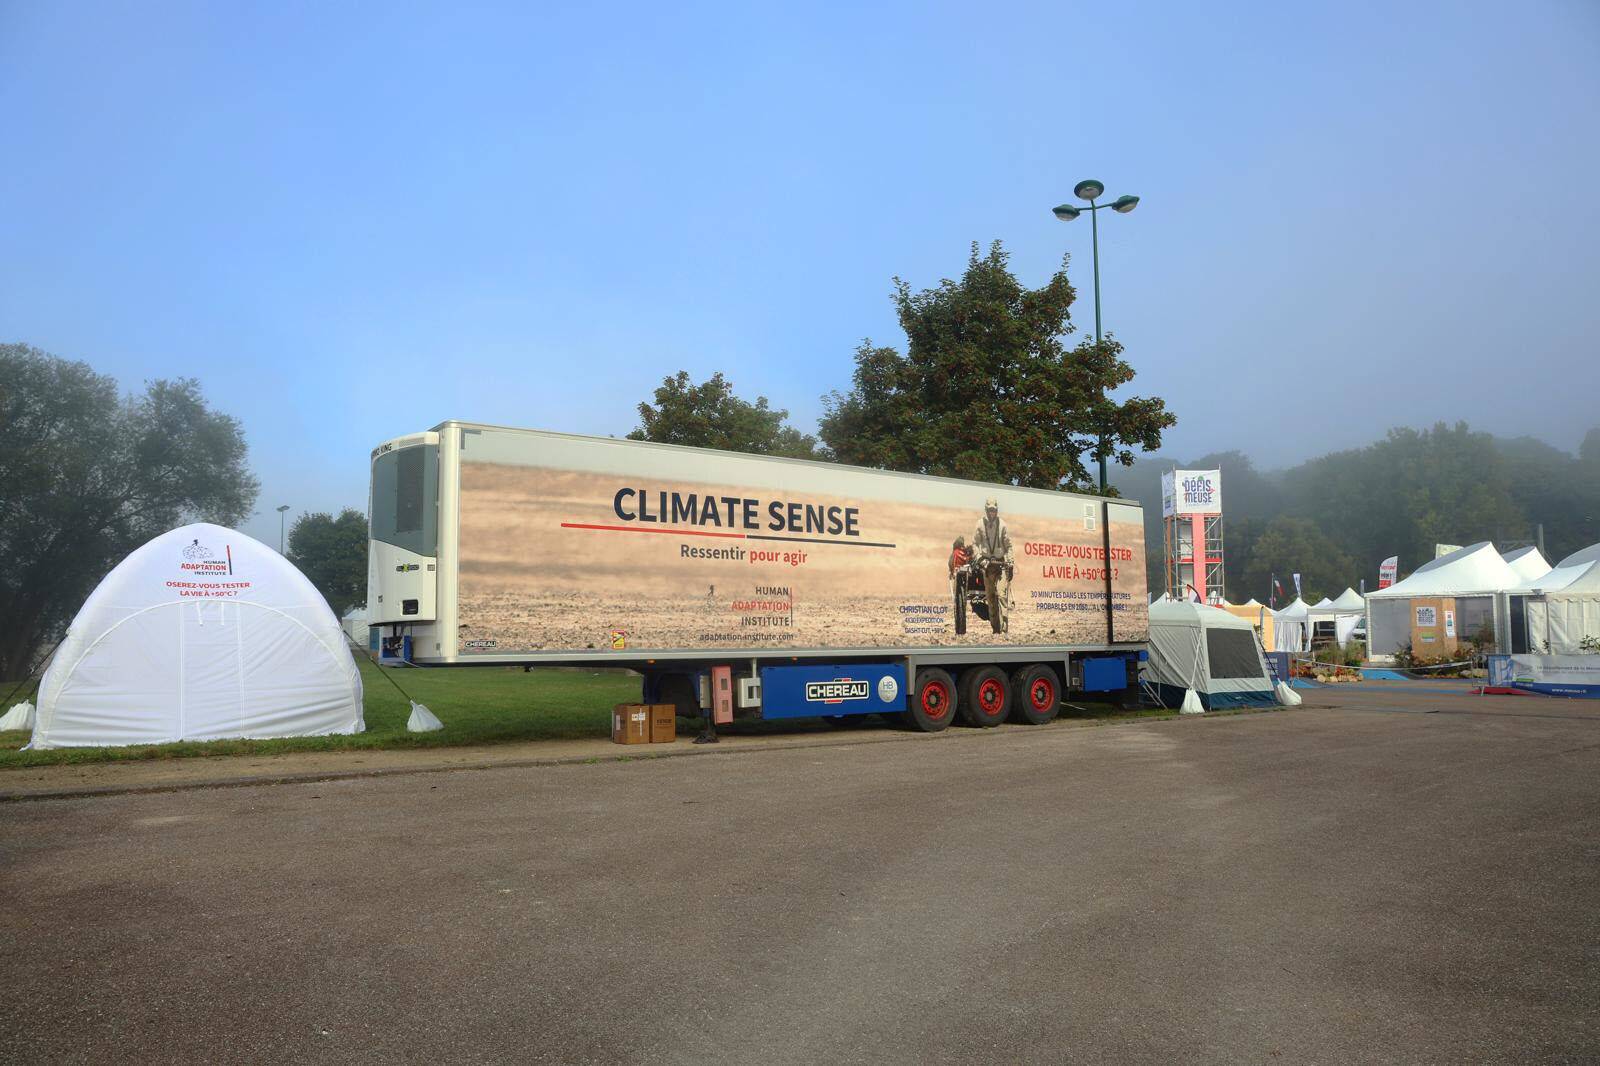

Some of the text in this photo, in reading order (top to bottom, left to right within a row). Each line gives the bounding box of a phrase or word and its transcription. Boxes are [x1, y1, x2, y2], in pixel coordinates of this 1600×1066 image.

[1184, 492, 1212, 503] MEUSE
[613, 487, 860, 537] CLIMATE SENSE
[681, 544, 808, 566] Ressentir pour agir
[1024, 542, 1132, 561] OSEREZ-VOUS TESTER
[1042, 565, 1056, 578] LA
[1056, 566, 1071, 579] VIE
[1073, 563, 1080, 580] À
[1114, 568, 1119, 581] ?
[166, 581, 221, 589] OSEREZ-VOUS
[203, 589, 210, 597] À
[755, 586, 789, 596] HUMAN
[1078, 592, 1087, 600] LES
[732, 601, 789, 611] ADAPTATION
[899, 605, 949, 614] CHRISTIAN CLOT
[1037, 603, 1067, 611] PROBABLES
[1068, 603, 1076, 611] EN
[741, 617, 790, 627] INSTITUTE
[699, 632, 794, 643] adaptation-institute.com
[808, 684, 867, 698] CHEREAU
